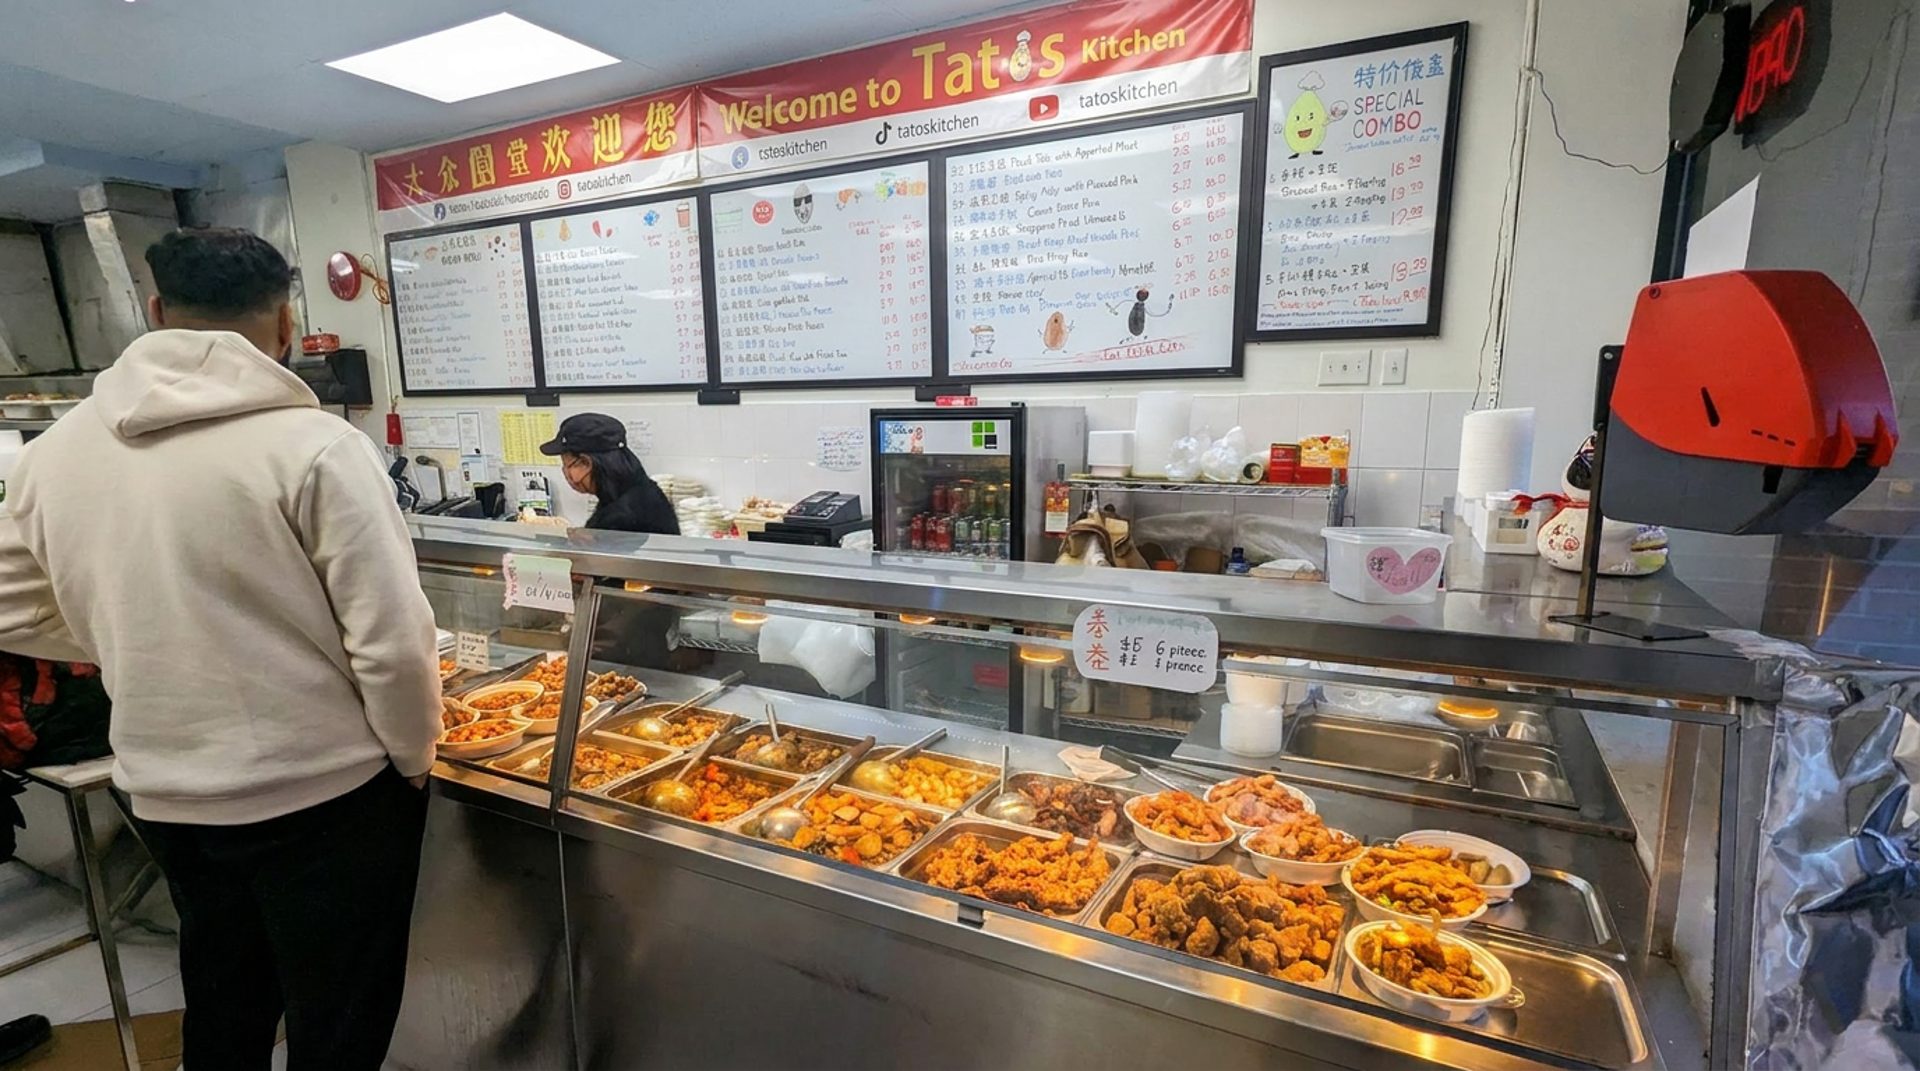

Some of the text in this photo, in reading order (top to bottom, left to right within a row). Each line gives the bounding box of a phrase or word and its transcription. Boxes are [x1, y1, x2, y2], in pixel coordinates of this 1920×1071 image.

[719, 86, 858, 135] Welcome
[866, 77, 902, 109] to
[1081, 27, 1187, 64] Kitchen
[1078, 79, 1179, 109] tatoskitchen
[1354, 88, 1424, 116] SPECIAL
[897, 113, 980, 140] tatoskitchen
[1353, 110, 1422, 139] COMBO
[1155, 640, 1166, 656] 6
